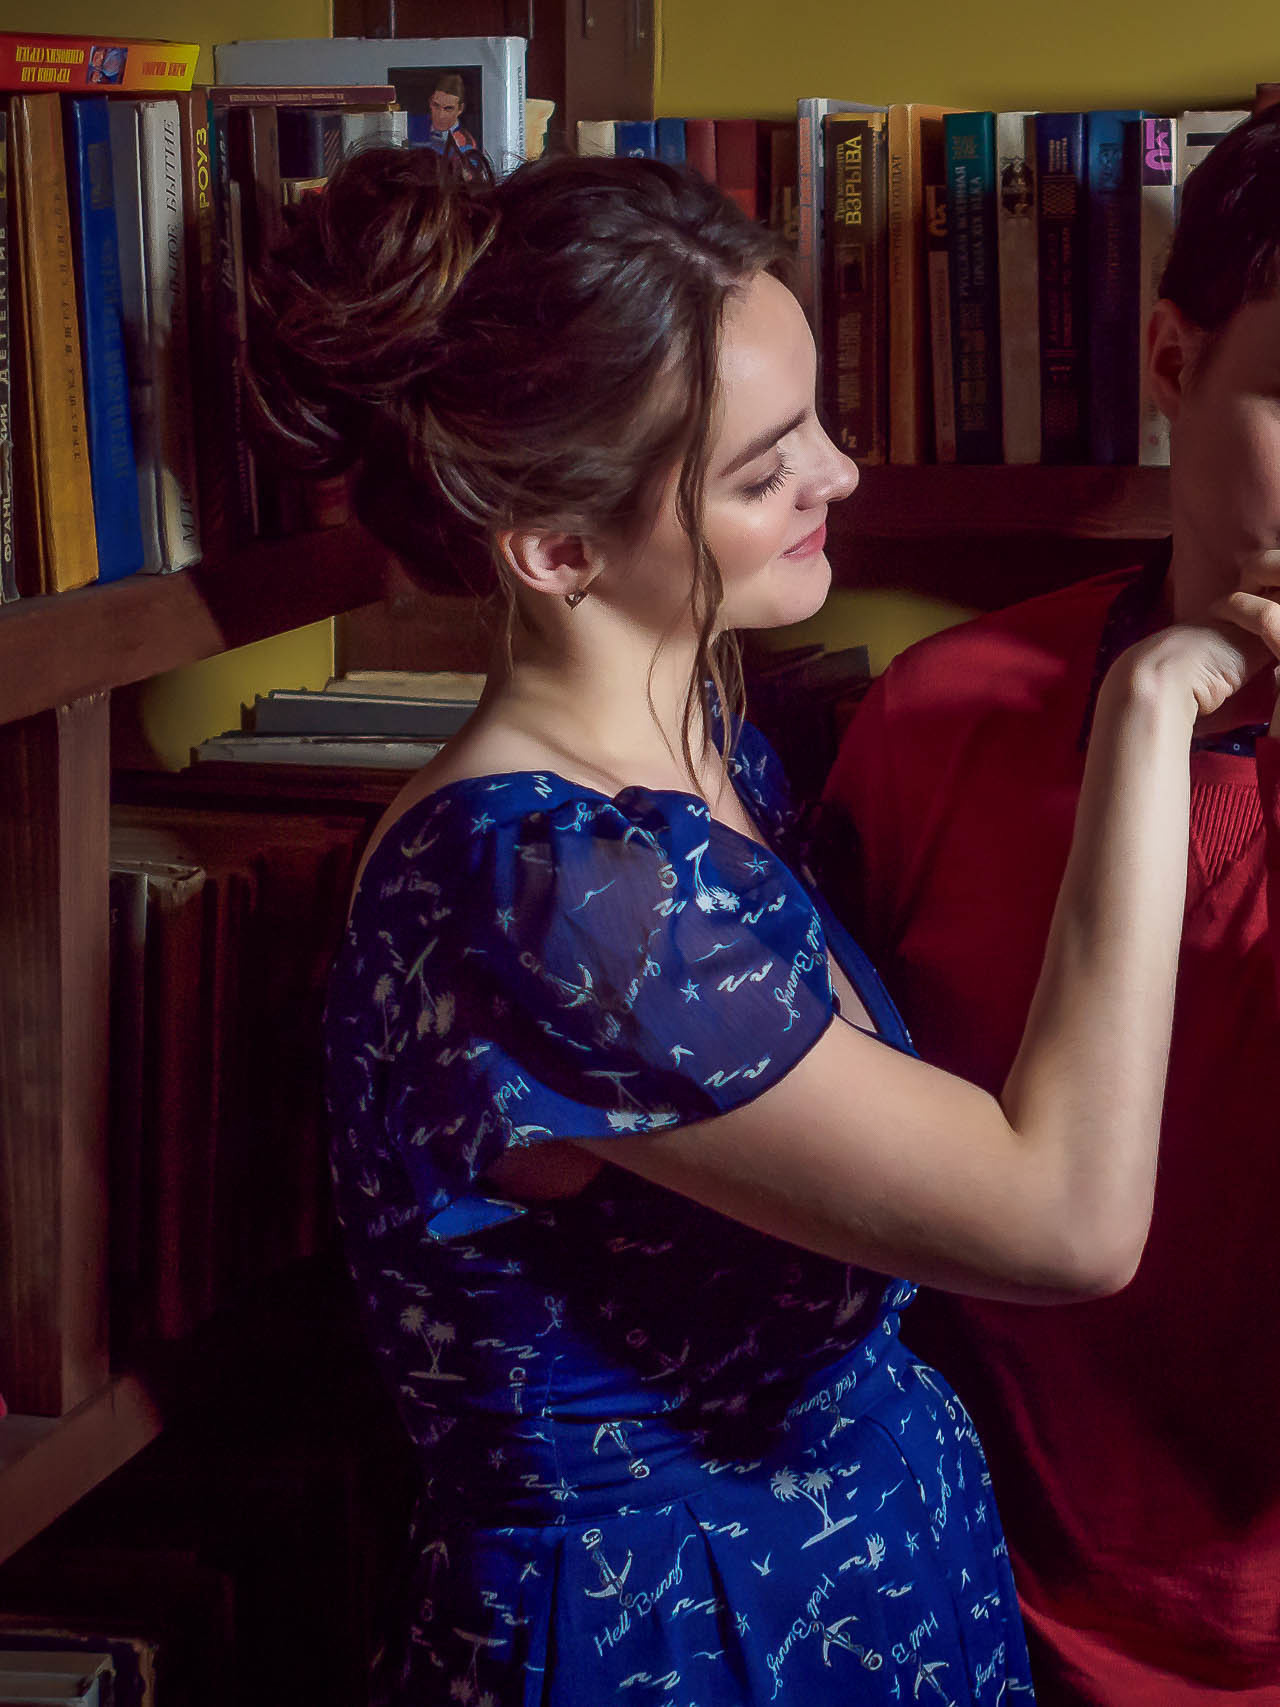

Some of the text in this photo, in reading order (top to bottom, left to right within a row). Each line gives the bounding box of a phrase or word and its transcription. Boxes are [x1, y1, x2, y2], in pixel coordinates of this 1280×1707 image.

[164, 118, 179, 214] БЫТИЕ
[844, 134, 864, 225] ВЗРЫВА
[774, 949, 816, 1033] Bunny
[593, 1533, 698, 1659] Hell Bunny
[766, 1572, 836, 1700] Hell Bunny
[908, 1610, 940, 1652] Hell
